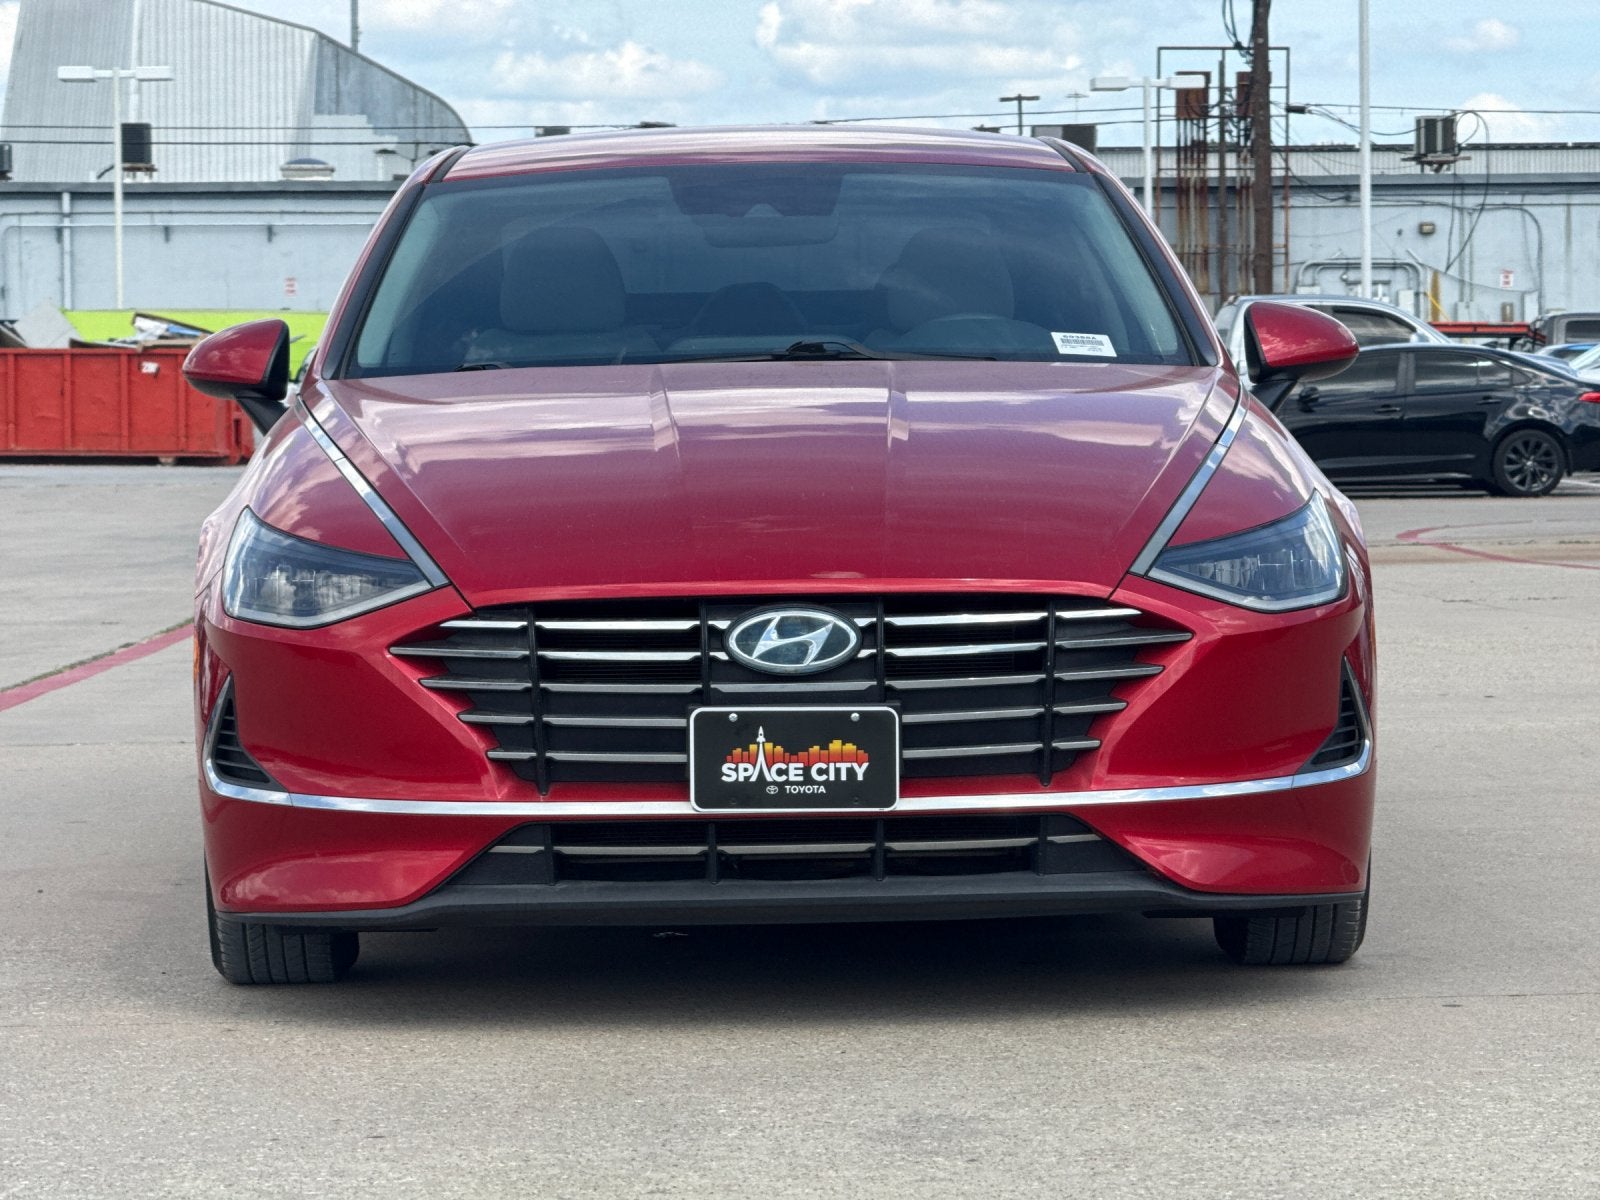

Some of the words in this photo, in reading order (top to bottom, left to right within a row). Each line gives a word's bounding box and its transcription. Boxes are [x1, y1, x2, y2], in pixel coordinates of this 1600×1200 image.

[721, 744, 804, 782] SPACE
[810, 762, 870, 781] CITY
[785, 785, 826, 794] TOYOTA
